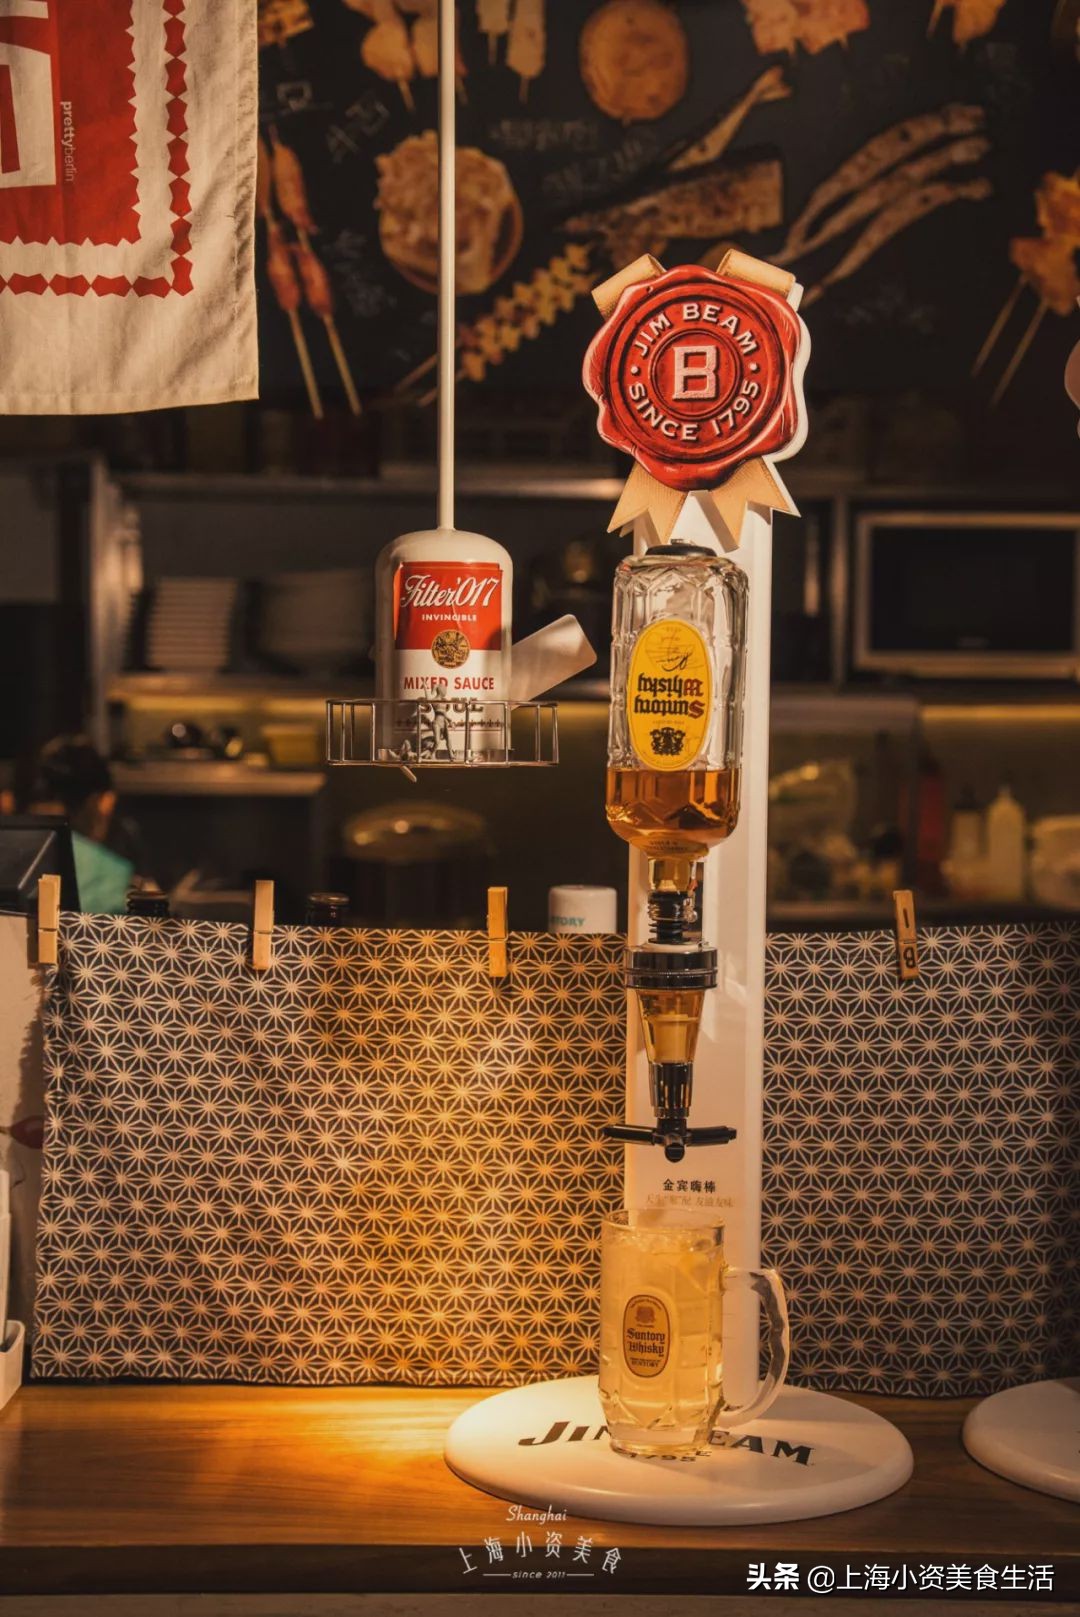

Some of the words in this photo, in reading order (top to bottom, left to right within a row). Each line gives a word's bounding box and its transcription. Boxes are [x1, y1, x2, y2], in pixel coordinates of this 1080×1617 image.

[633, 312, 673, 358] JIM
[682, 302, 758, 355] BEAM
[672, 345, 720, 400] B
[629, 381, 698, 441] SINCE
[710, 380, 759, 437] 1795
[400, 574, 500, 608] Filter'017
[421, 613, 478, 622] INVINCIBLE
[454, 676, 495, 690] SAUCE
[637, 672, 704, 698] Whisky
[634, 695, 705, 720] Suntory
[627, 1328, 665, 1344] Suntory
[628, 1341, 664, 1357] Whisky
[708, 1431, 814, 1466] EAM
